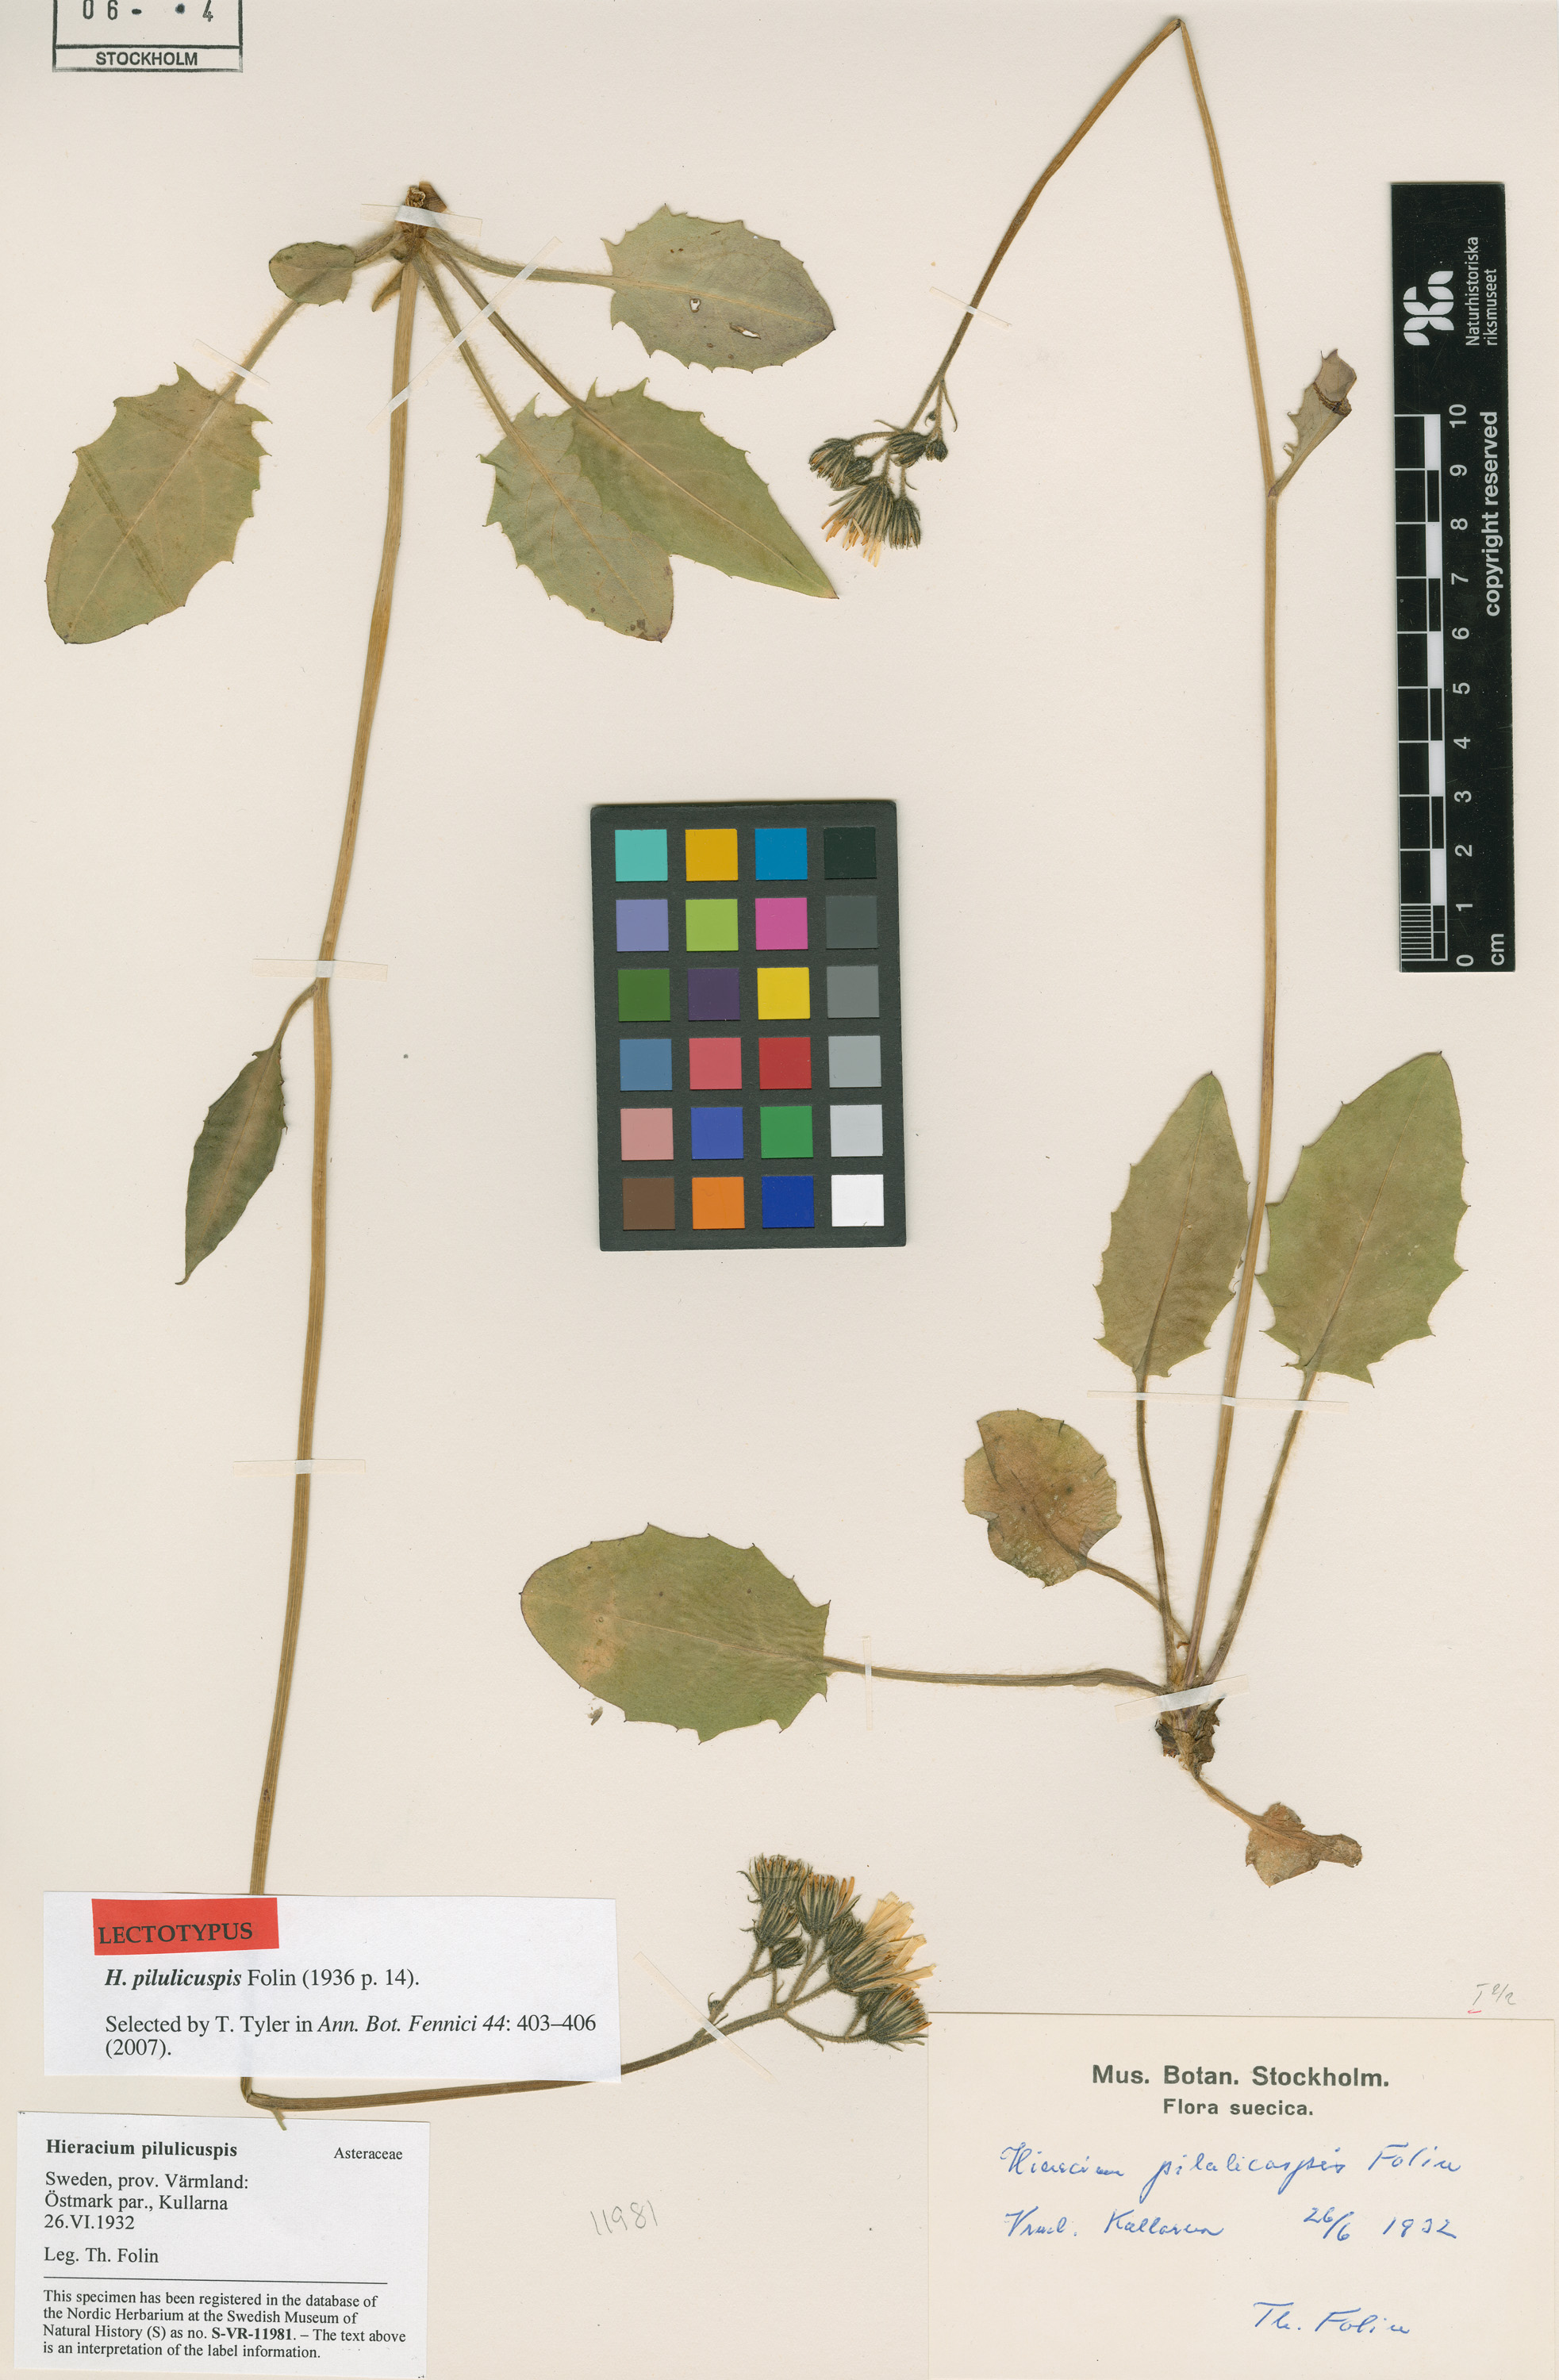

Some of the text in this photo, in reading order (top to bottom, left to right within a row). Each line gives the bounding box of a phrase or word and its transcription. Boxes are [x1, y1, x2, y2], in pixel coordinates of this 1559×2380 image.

[95, 51, 198, 66] STOCKHOLM
[1463, 236, 1480, 346] Naturhistoriska
[1482, 268, 1498, 346] riksmuseet
[1448, 404, 1467, 428] 10
[1449, 464, 1468, 477] 9
[1479, 411, 1504, 617] copyright reserved
[1450, 517, 1469, 531] 8
[1450, 572, 1469, 585] 7
[1451, 627, 1470, 640] 6
[1452, 682, 1471, 695] 5
[1453, 736, 1471, 750] 4
[1453, 790, 1472, 803] 3
[1454, 844, 1473, 858] 2
[1455, 903, 1473, 912] 1
[1490, 933, 1505, 966] cm
[1456, 954, 1474, 967] 0
[98, 1922, 253, 1944] LECTOTYPUS
[104, 1968, 419, 1990] H. pilulicuspis Folin (1936 p. 14).
[106, 2014, 596, 2037] Selected by T. Tyler in Ann. Bot. Fennici 44: 403–406
[106, 2038, 171, 2059] (2007).
[1092, 2064, 1389, 2087] Mus. Botan. Stockholm.
[1163, 2098, 1313, 2116] Flora suecica.
[46, 2139, 237, 2160] Hieracium pilulicuspis
[333, 2147, 403, 2160] Asteraceae
[45, 2171, 248, 2193] Sweden, prov. Värmland:
[44, 2190, 228, 2213] Östmark par., Kullarna
[44, 2213, 135, 2230] 26.VI.1932
[589, 2200, 658, 2236] 11981
[1382, 2217, 1457, 2240] 1932
[44, 2247, 159, 2266] Leg. Th. Folin
[43, 2290, 378, 2308] This specimen has been registered in the database of
[43, 2306, 359, 2324] the Nordic Herbarium at the Swedish Museum of
[43, 2324, 90, 2337] Natural
[95, 2324, 143, 2341] History
[147, 2325, 167, 2341] (S)
[170, 2329, 183, 2339] as
[187, 2329, 207, 2339] no.
[212, 2327, 296, 2340] S-VR-11981.
[313, 2328, 336, 2341] The
[340, 2330, 365, 2342] text
[369, 2329, 406, 2343] above
[44, 2341, 321, 2358] is an interpretation of the label information.
